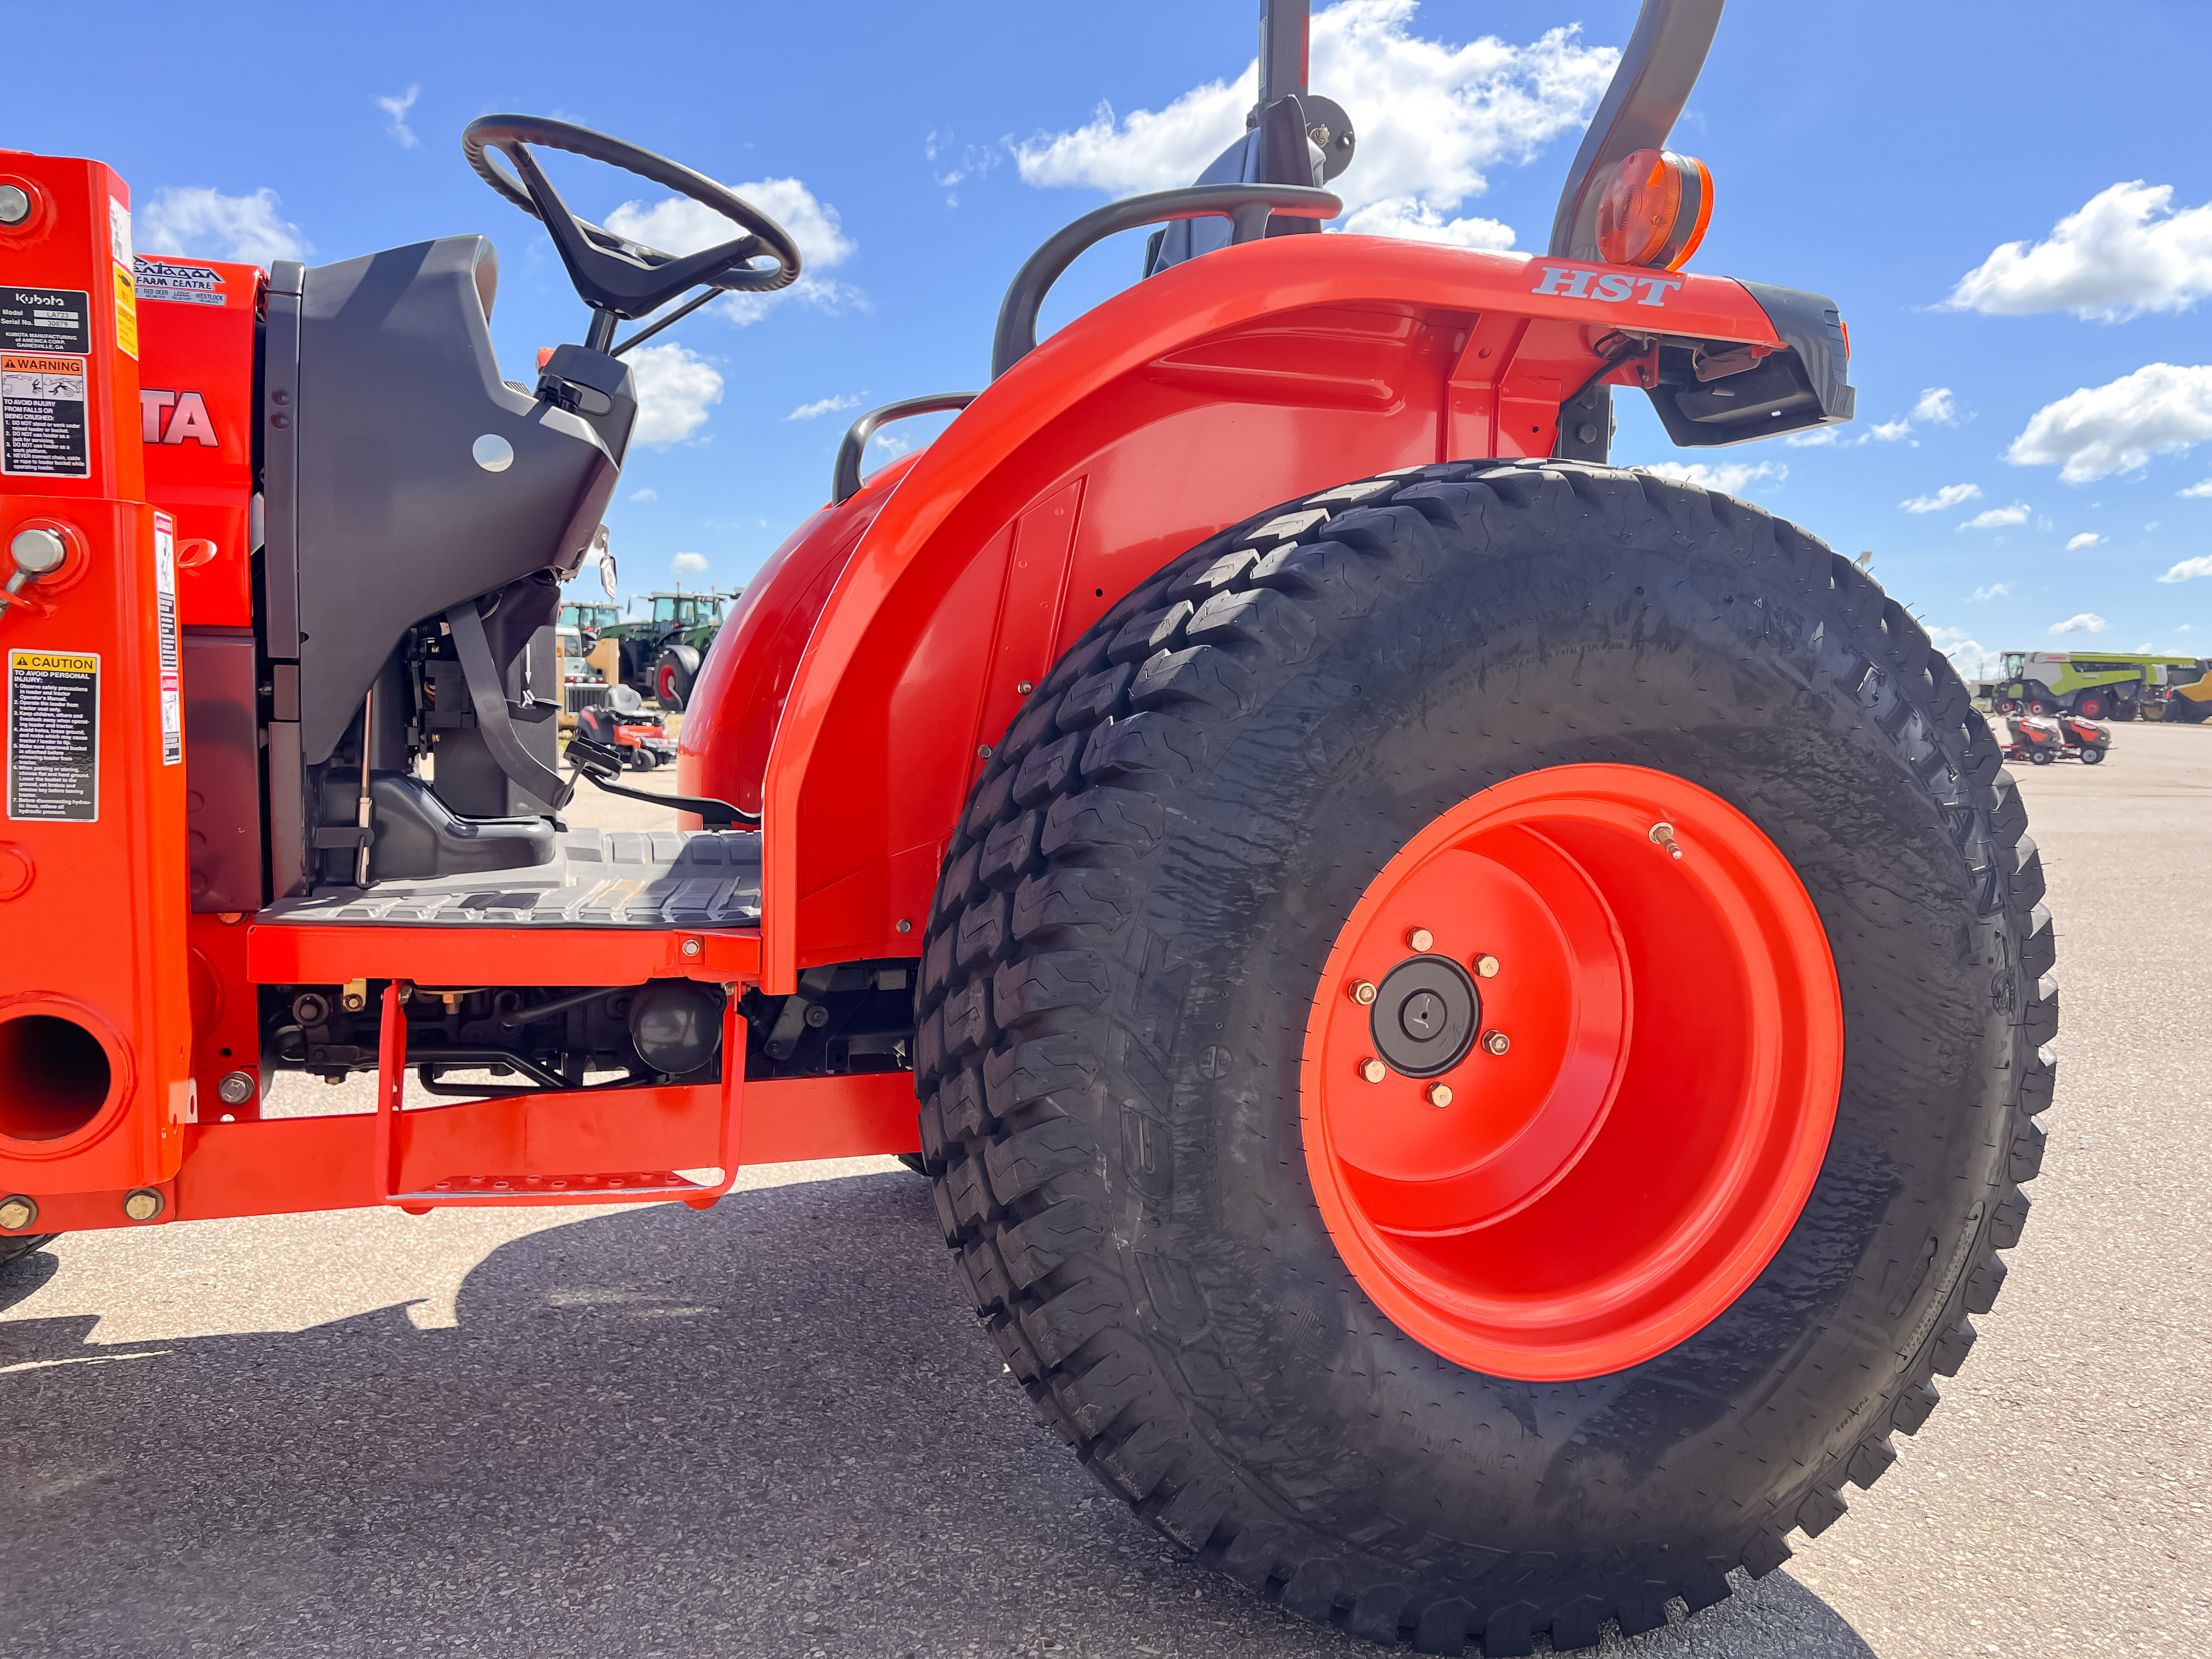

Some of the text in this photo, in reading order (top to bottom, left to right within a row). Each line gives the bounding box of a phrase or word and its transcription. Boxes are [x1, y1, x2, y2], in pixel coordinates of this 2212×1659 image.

[136, 276, 212, 290] FARM CENTRE
[1531, 267, 1682, 307] HST
[15, 292, 64, 307] Kubota
[196, 293, 223, 301] WESTLOCK
[18, 358, 80, 371] WARNING
[32, 657, 93, 670] CAUTION
